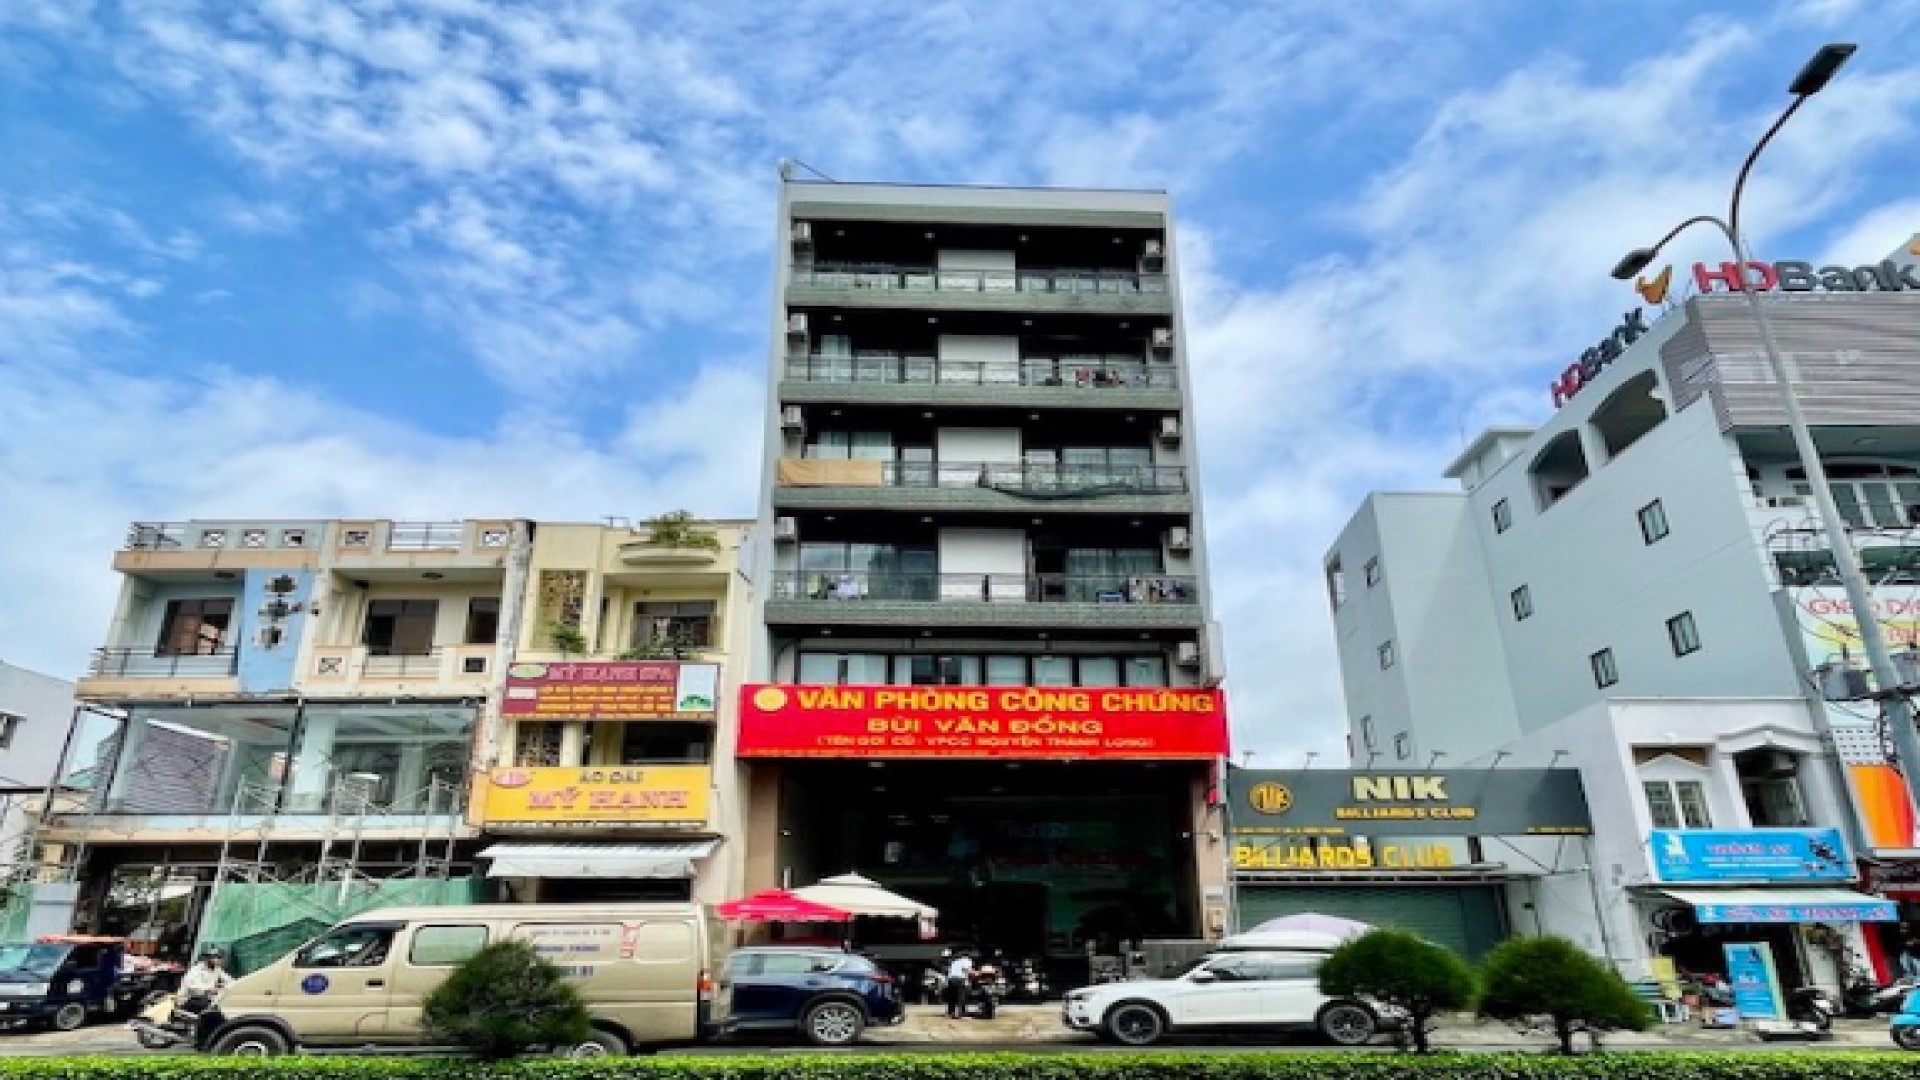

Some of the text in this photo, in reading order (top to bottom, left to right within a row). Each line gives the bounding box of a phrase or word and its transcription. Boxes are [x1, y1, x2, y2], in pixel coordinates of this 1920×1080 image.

[1692, 258, 1920, 293] HDBank
[1550, 306, 1649, 408] HDBank
[797, 686, 1214, 712] VĂN PHÒNG CÔNG CHỨNG
[867, 715, 921, 732] BÙI
[934, 715, 1000, 733] VĂN
[1353, 775, 1448, 800] NIK
[1430, 806, 1476, 819] CLUB
[1233, 844, 1454, 868] BILLIARDS CLUB
